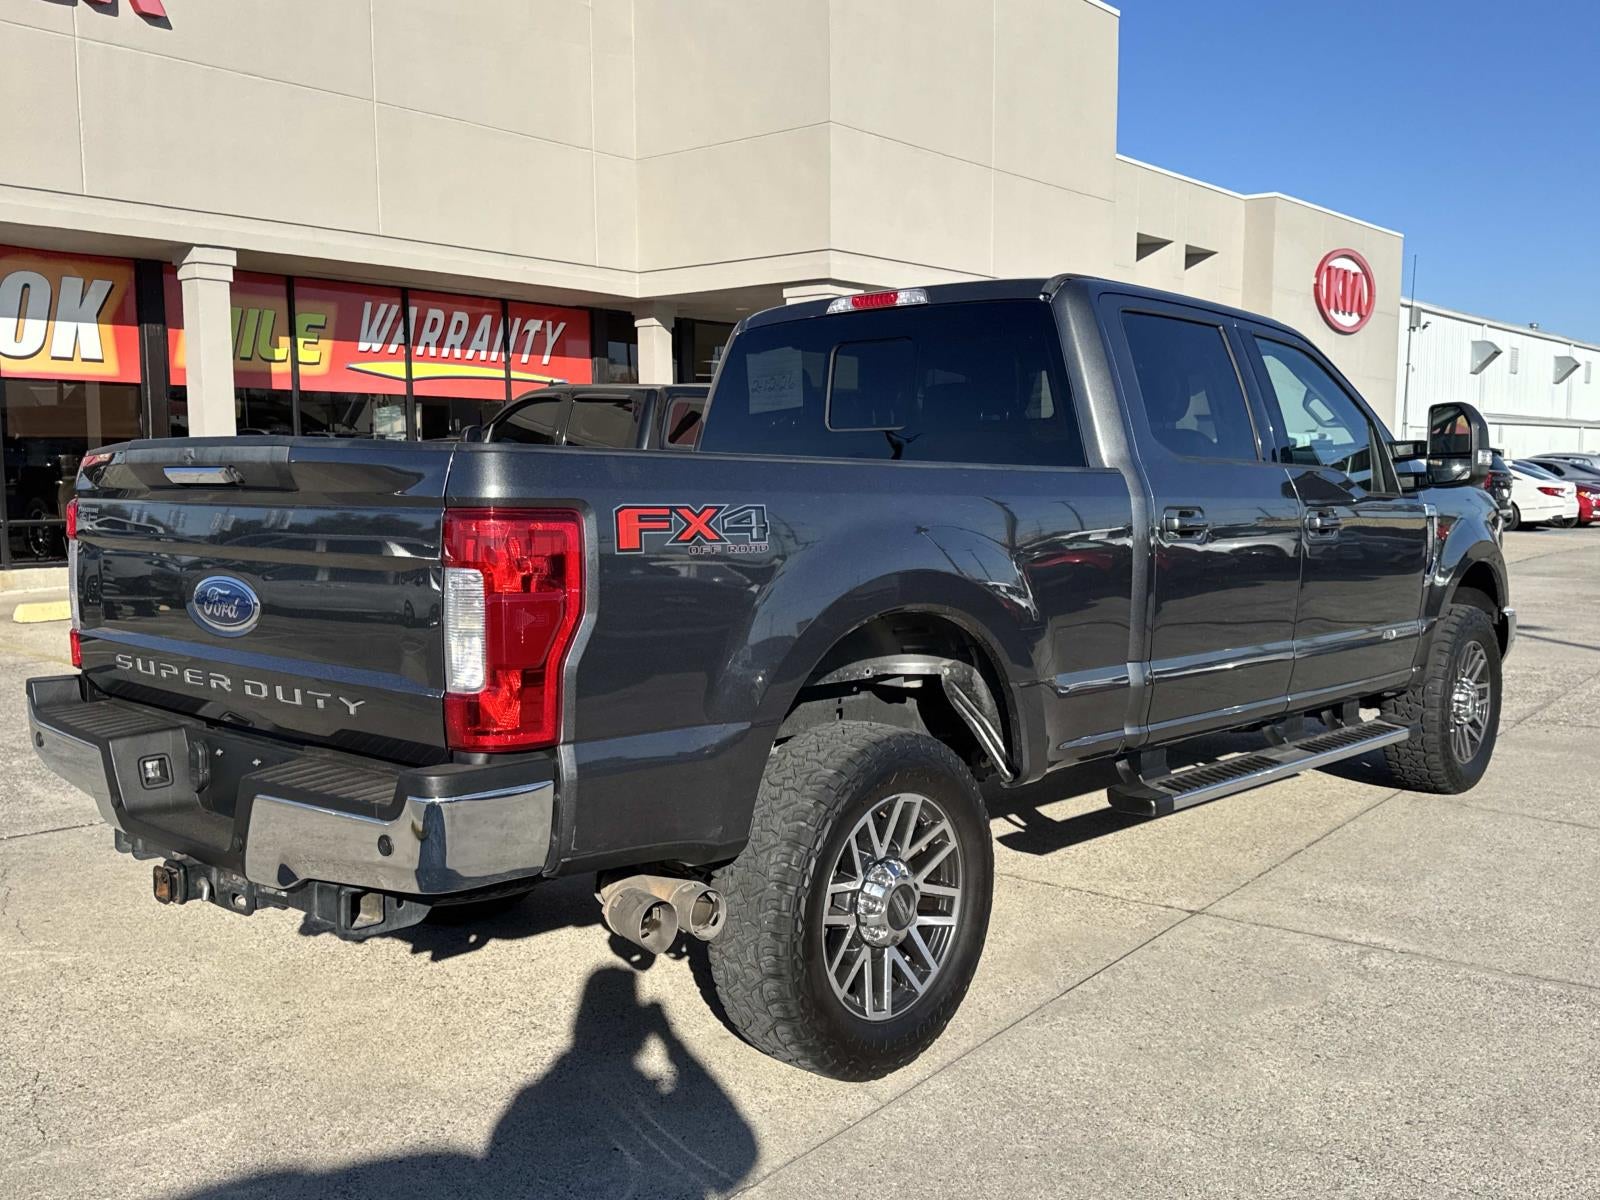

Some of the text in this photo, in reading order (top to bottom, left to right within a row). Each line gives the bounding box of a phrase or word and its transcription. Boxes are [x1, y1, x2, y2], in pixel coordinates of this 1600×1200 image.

[1325, 265, 1367, 316] KIA
[357, 301, 566, 366] WARRANTY
[613, 504, 770, 555] FX4
[688, 544, 769, 555] OFF ROAD
[203, 586, 239, 618] Ford
[115, 654, 366, 716] SUPER DUTY
